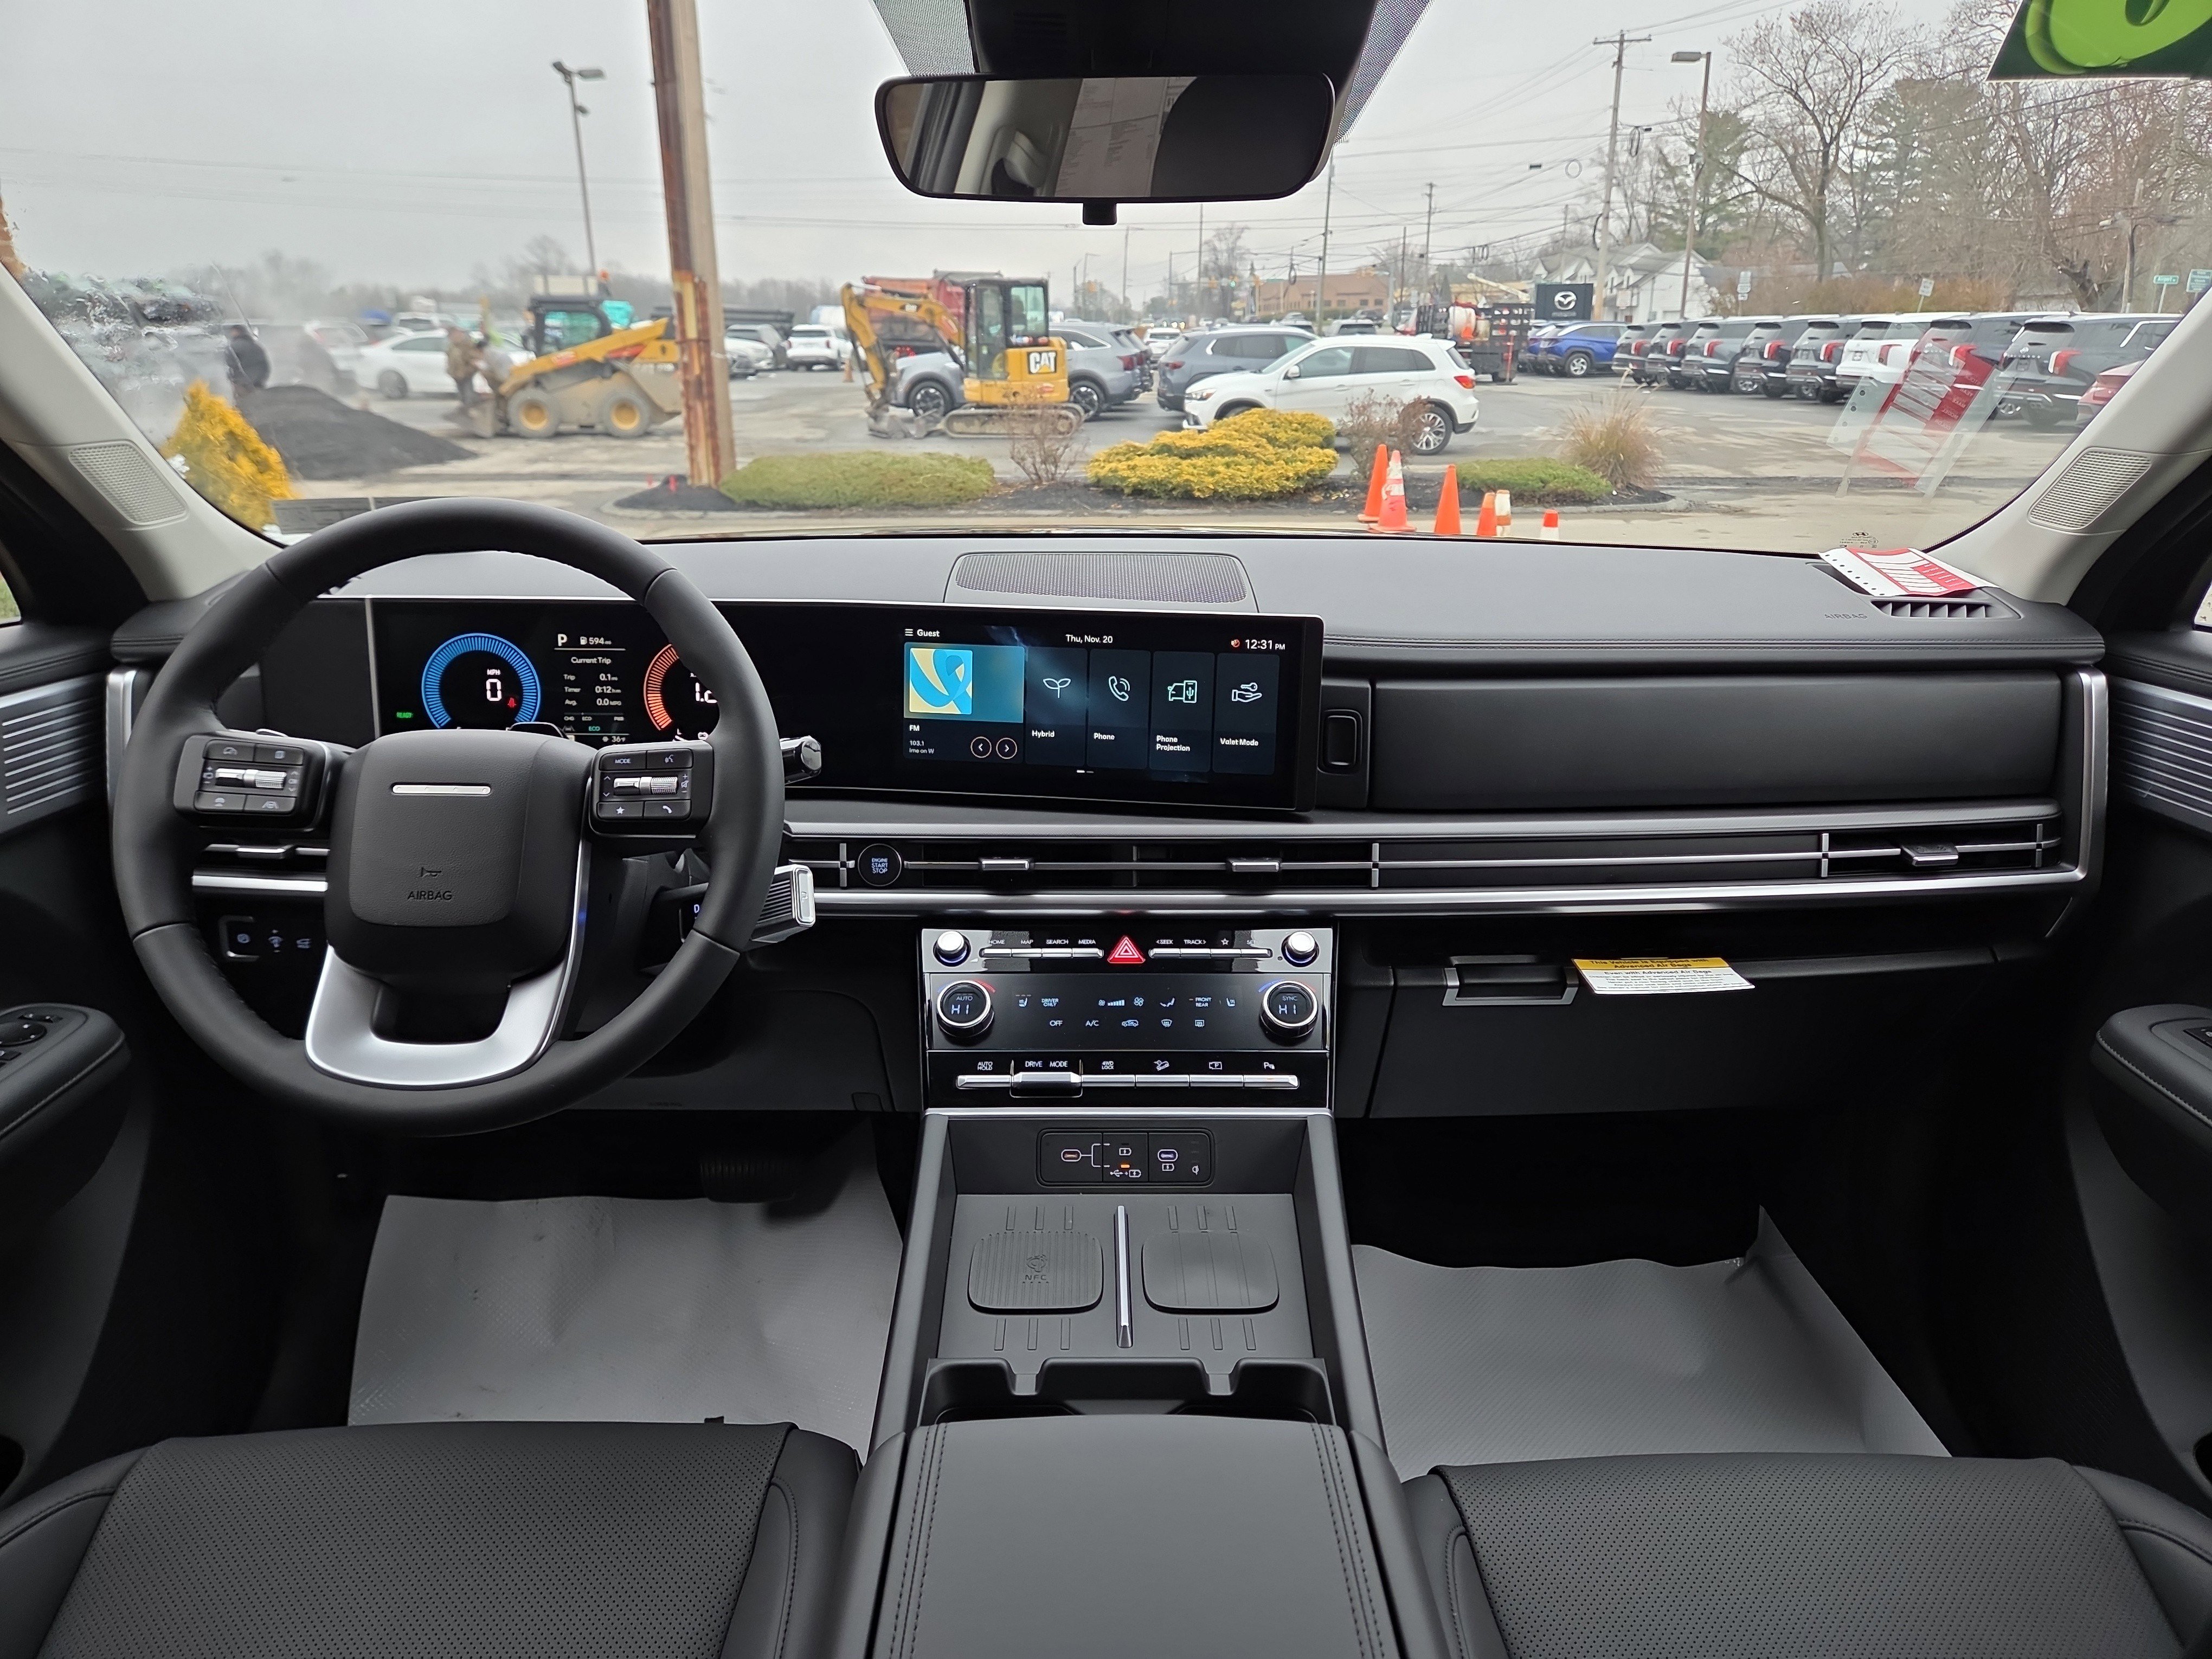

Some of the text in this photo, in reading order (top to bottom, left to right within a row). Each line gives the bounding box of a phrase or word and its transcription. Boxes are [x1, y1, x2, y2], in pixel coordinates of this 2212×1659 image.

[1030, 351, 1056, 374] CAT
[916, 629, 940, 638] Guest
[557, 633, 568, 647] P
[589, 636, 605, 645] 594
[1065, 634, 1114, 644] Thu, Nov. 20
[1245, 639, 1272, 650] 12:31
[597, 657, 612, 665] Trip
[599, 673, 611, 681] 0.1
[486, 678, 502, 702] 0
[595, 685, 612, 693] 0:12
[596, 698, 609, 706] 0.0
[1032, 730, 1055, 738] Hybrid
[1094, 732, 1115, 741] Phone
[1156, 735, 1178, 743] Phone
[1220, 738, 1239, 746] Valet
[1156, 744, 1191, 752] Projection
[407, 891, 453, 901] AIRBAG
[693, 904, 700, 914] D
[951, 1004, 970, 1014] HI
[1278, 1004, 1297, 1015] HI
